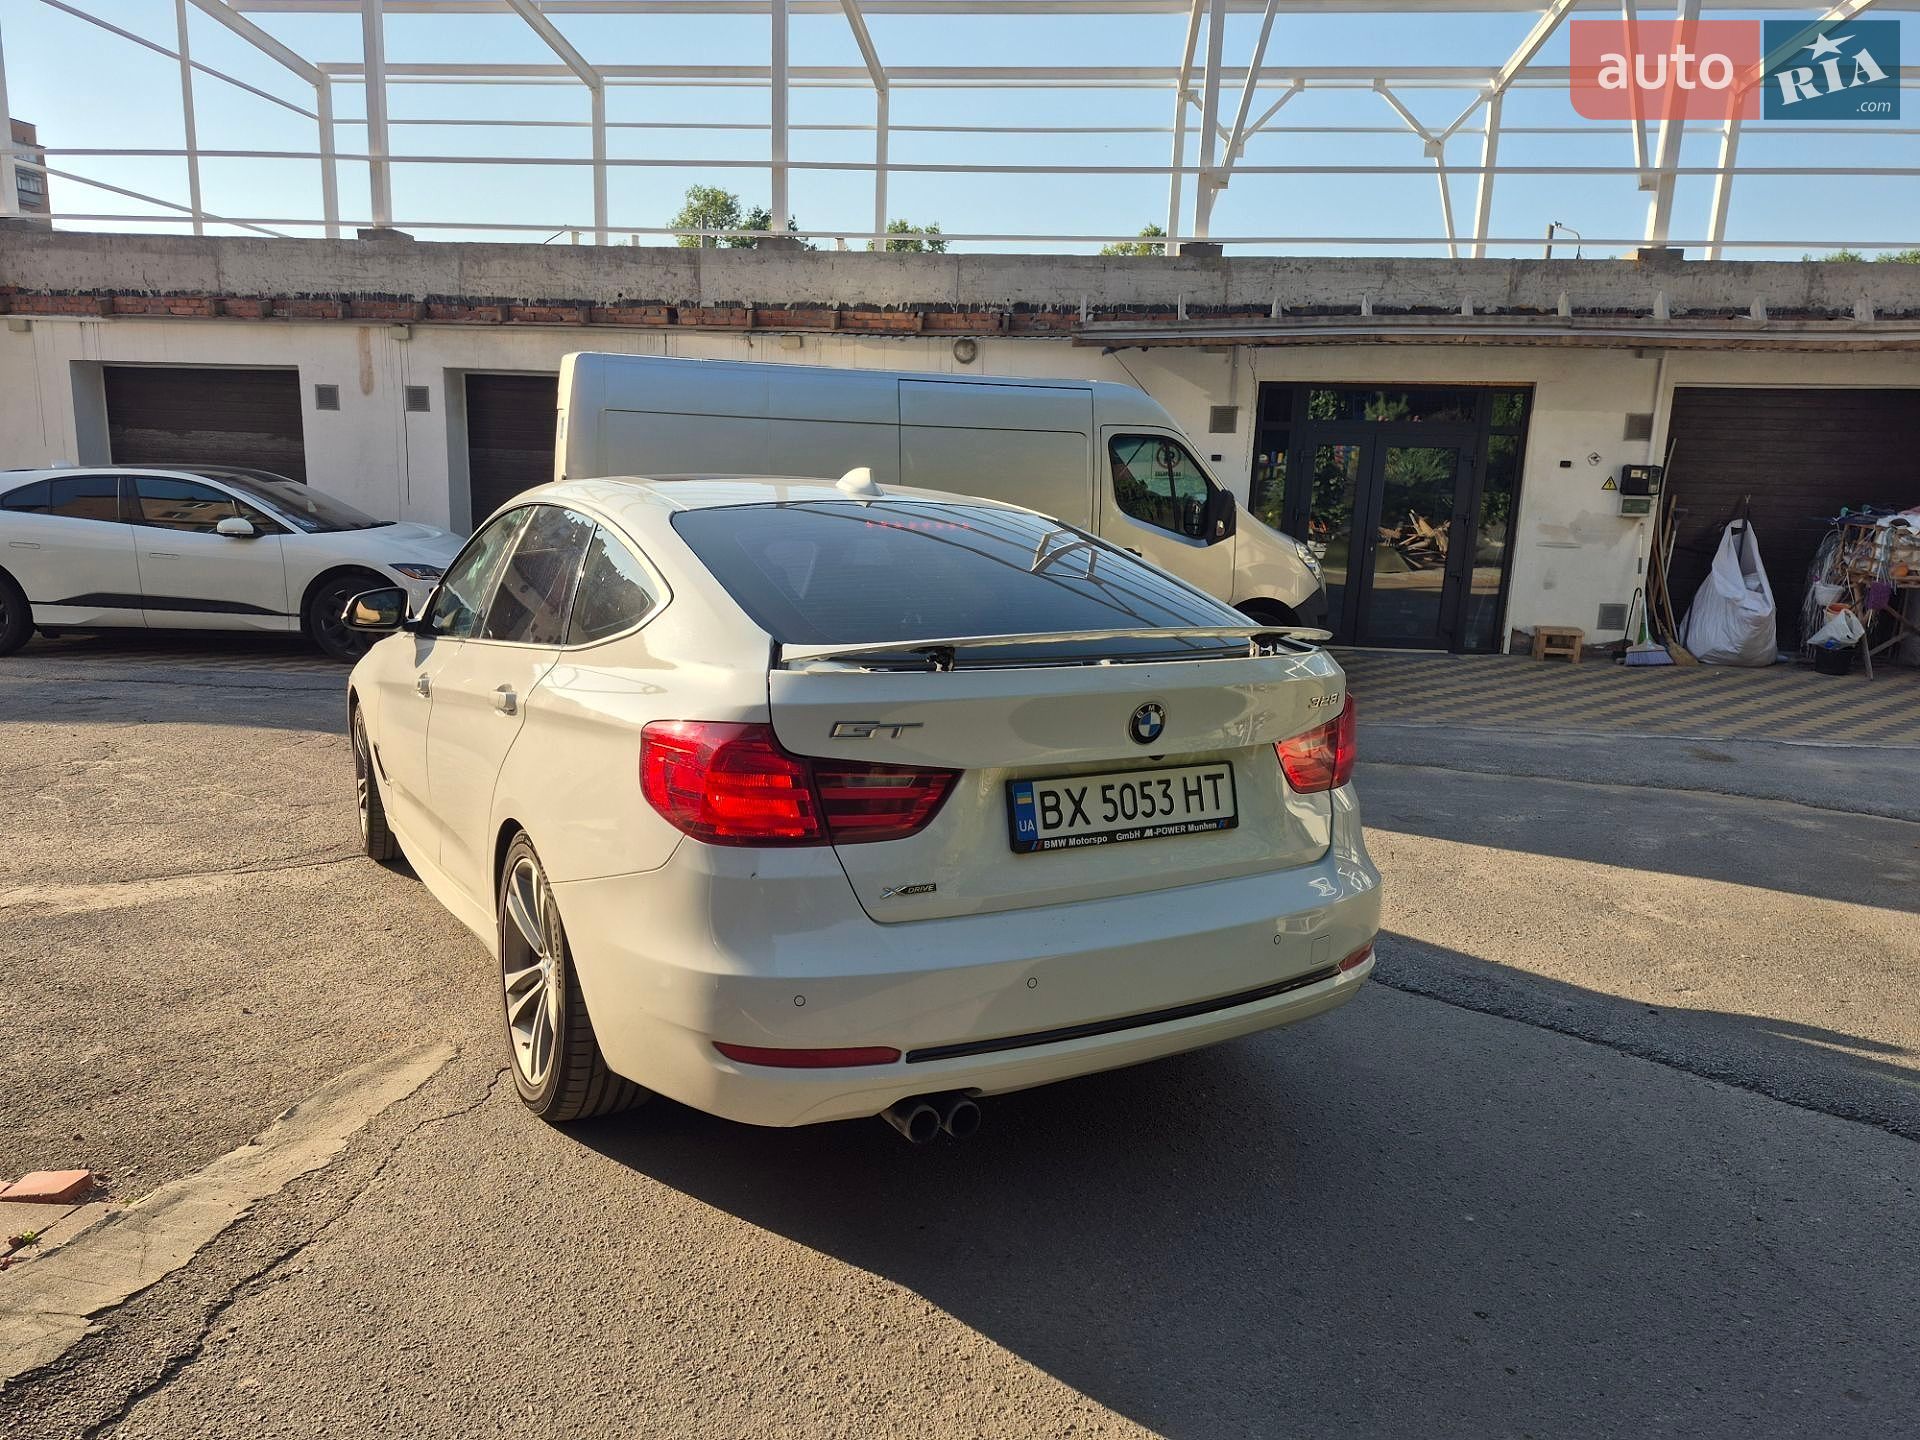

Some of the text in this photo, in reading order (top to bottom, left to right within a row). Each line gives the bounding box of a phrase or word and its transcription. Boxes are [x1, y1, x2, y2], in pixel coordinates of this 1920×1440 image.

[829, 720, 924, 739] GT
[1039, 773, 1225, 831] BX 5053 HT
[1018, 819, 1035, 832] UA
[1044, 838, 1067, 849] BMW
[1115, 830, 1141, 841] GmbH
